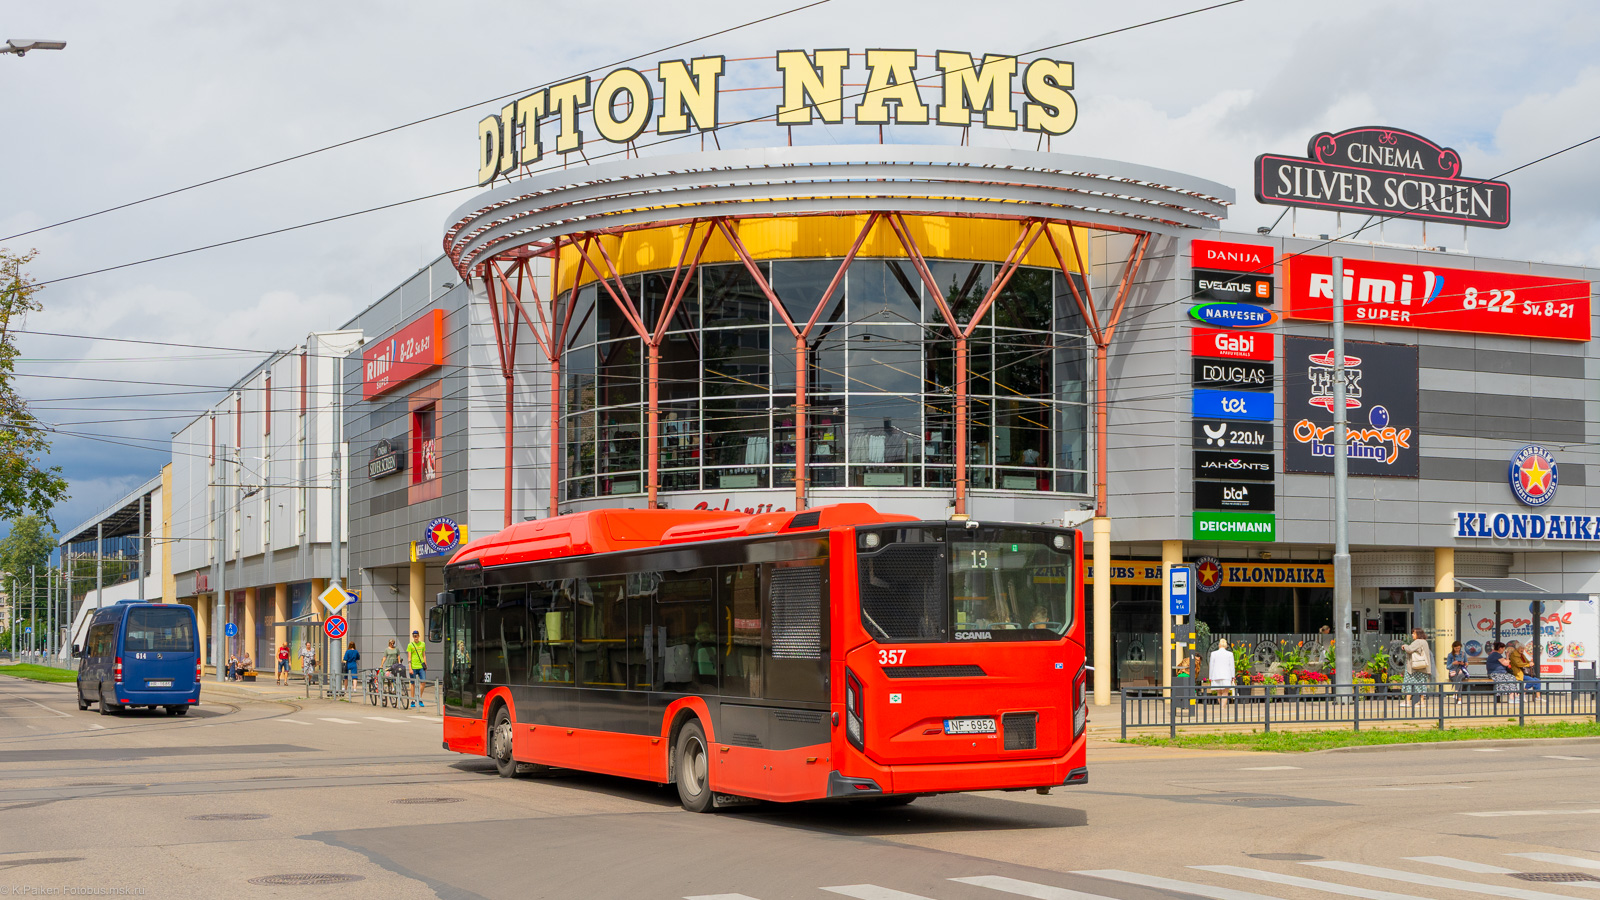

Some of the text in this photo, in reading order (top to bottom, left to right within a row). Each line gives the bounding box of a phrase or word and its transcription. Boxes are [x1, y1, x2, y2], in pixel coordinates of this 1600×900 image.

[478, 48, 1078, 187] DITTON NAMS
[1347, 142, 1425, 171] CINEMA
[1278, 164, 1494, 218] SILVER SCREEN
[1207, 250, 1261, 264] DANIJA
[1199, 280, 1252, 293] EVELATUS
[1463, 287, 1516, 313] 8-22
[1523, 300, 1543, 316] Sv.
[1545, 302, 1574, 319] 8-21
[1206, 308, 1264, 321] NARVESEN
[1356, 307, 1411, 322] SUPER
[400, 337, 414, 363] 8-22
[1215, 333, 1254, 352] Gabi
[1203, 365, 1265, 384] DOUGLAS
[1221, 397, 1247, 413] tet
[1229, 430, 1265, 446] 220.lv
[1515, 446, 1555, 468] KLONDAIKA
[1223, 486, 1243, 500] bta
[1199, 521, 1272, 533] DEICHMANN
[971, 550, 988, 569] 13
[1228, 567, 1326, 583] KLONDAIKA
[954, 631, 992, 640] SCANIA
[135, 652, 147, 660] 614
[878, 649, 907, 665] 357
[951, 720, 994, 731] NF-6952
